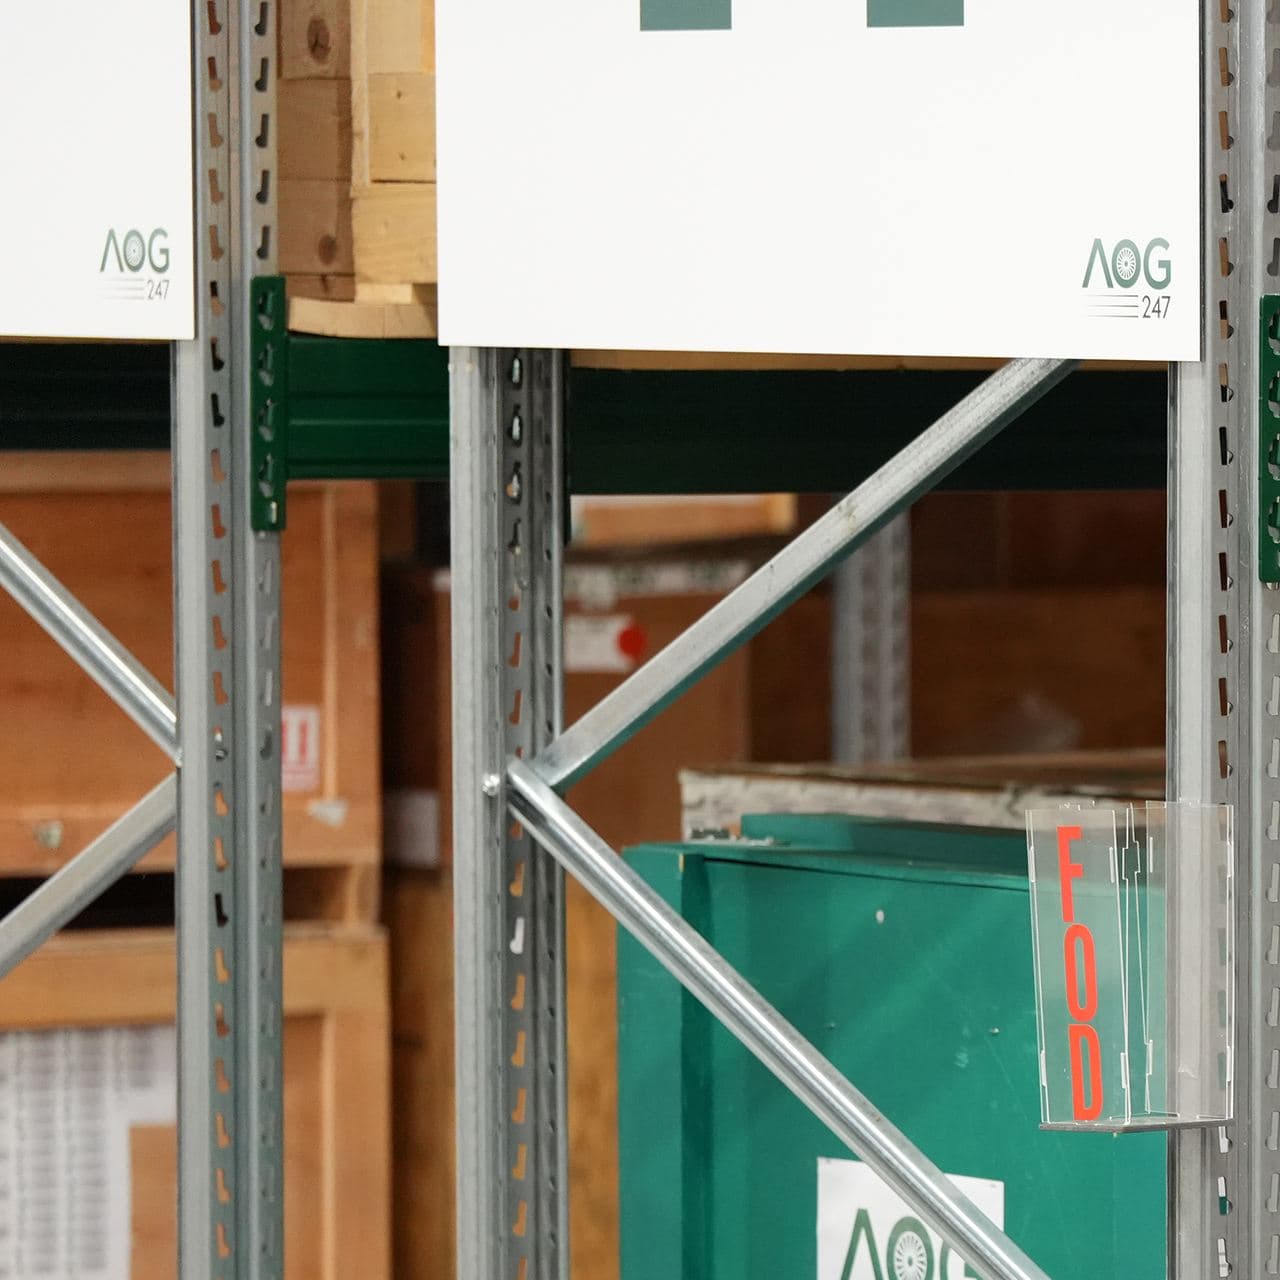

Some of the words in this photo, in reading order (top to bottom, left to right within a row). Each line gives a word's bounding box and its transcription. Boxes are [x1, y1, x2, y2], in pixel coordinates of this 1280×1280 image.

[100, 228, 169, 273] AOG
[1082, 237, 1171, 290] AOG
[147, 279, 169, 300] 247
[1142, 295, 1171, 319] 247
[1056, 825, 1104, 1122] FOD
